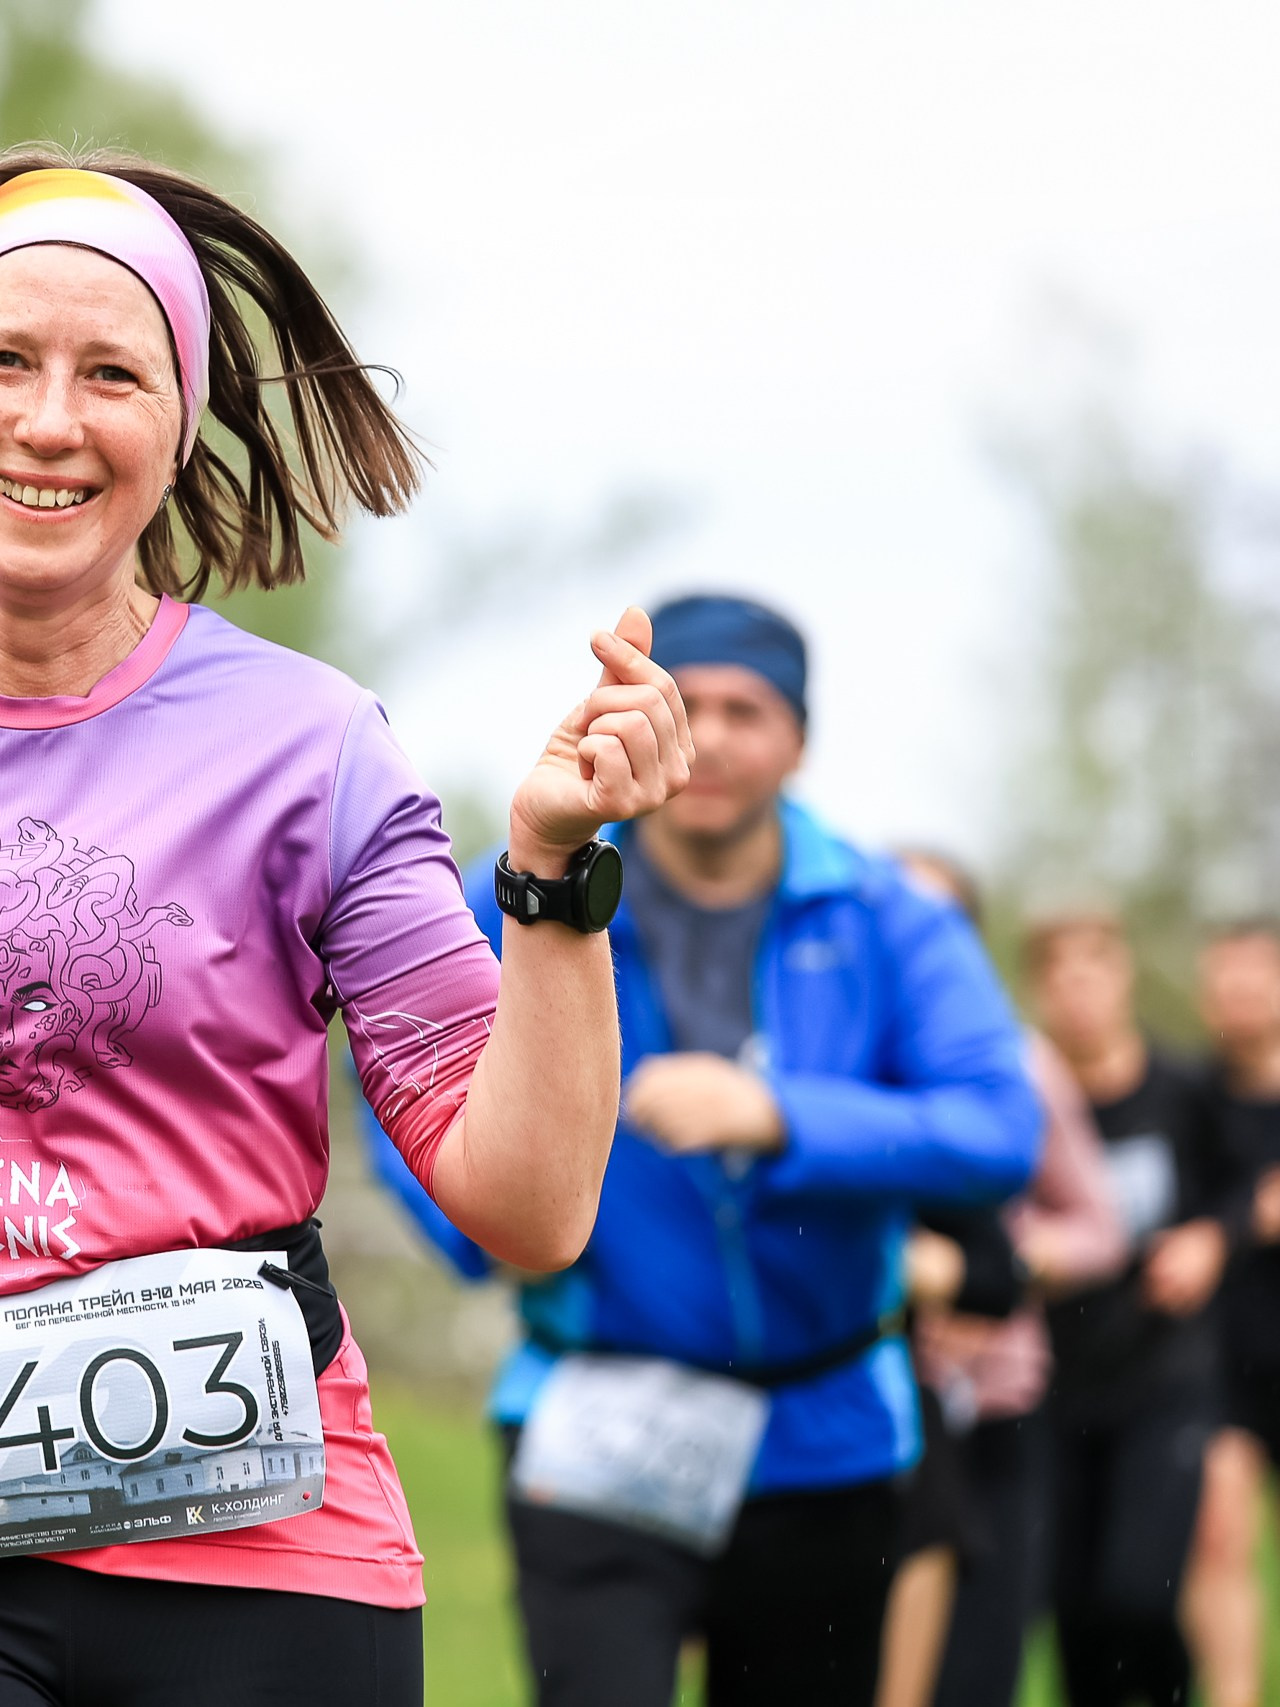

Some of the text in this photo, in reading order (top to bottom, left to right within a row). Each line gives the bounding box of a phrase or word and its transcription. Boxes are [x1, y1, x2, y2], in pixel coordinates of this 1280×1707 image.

[4, 1300, 73, 1323] ПОЛЯНА
[78, 1289, 135, 1311] ТРЕЙЛ
[141, 1286, 173, 1302] 9-10
[179, 1279, 216, 1297] МАЯ
[15, 1322, 31, 1331] БЕГ
[34, 1319, 46, 1328] ПО
[48, 1307, 114, 1325] ПЕРЕСЕЧЕННОЙ
[182, 1297, 196, 1307] КМ
[261, 1355, 280, 1420] ЭКСТРЕННОЙ
[273, 1421, 283, 1442] ДЛЯ
[211, 1493, 285, 1515] К-ХОЛДИНГ
[134, 1515, 172, 1528] ЭЛЬФ
